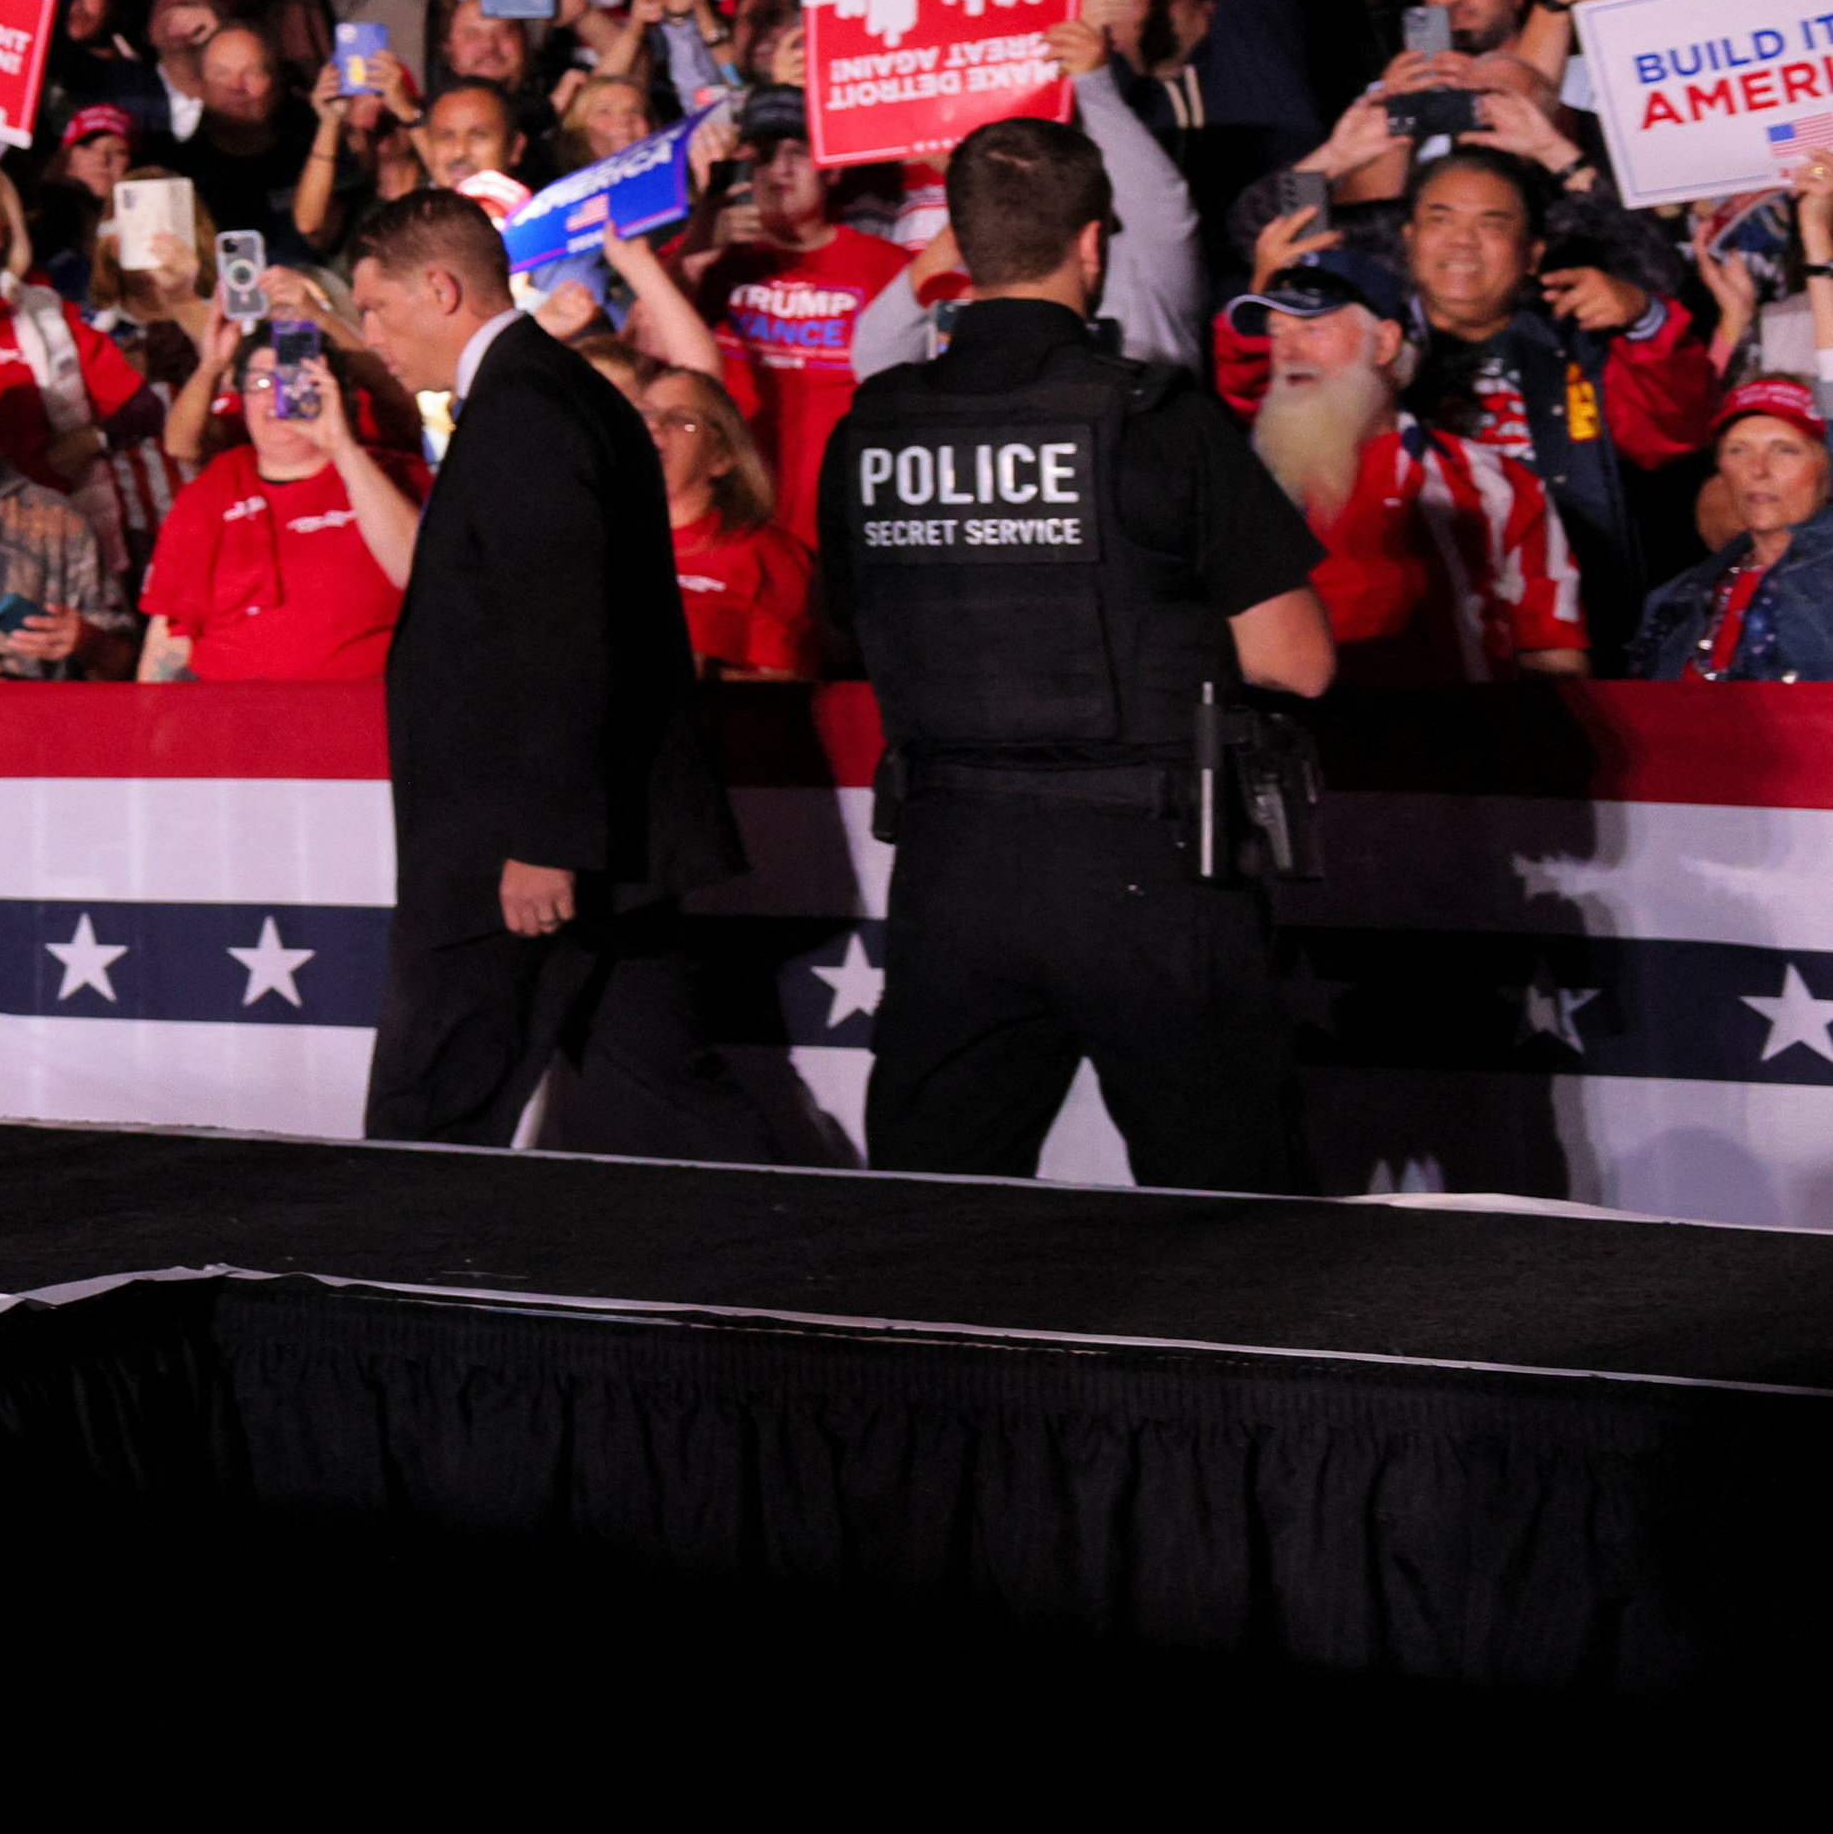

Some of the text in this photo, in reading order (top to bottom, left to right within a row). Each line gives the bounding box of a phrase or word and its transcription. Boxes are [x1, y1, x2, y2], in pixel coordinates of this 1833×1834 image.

[829, 45, 941, 84] AGAIN!
[1635, 28, 1785, 84] BUILD
[826, 69, 961, 111] DETROIT
[730, 283, 859, 319] TRUMP
[860, 442, 1080, 506] POLICE
[864, 518, 1083, 547] SECRET SERVICE
